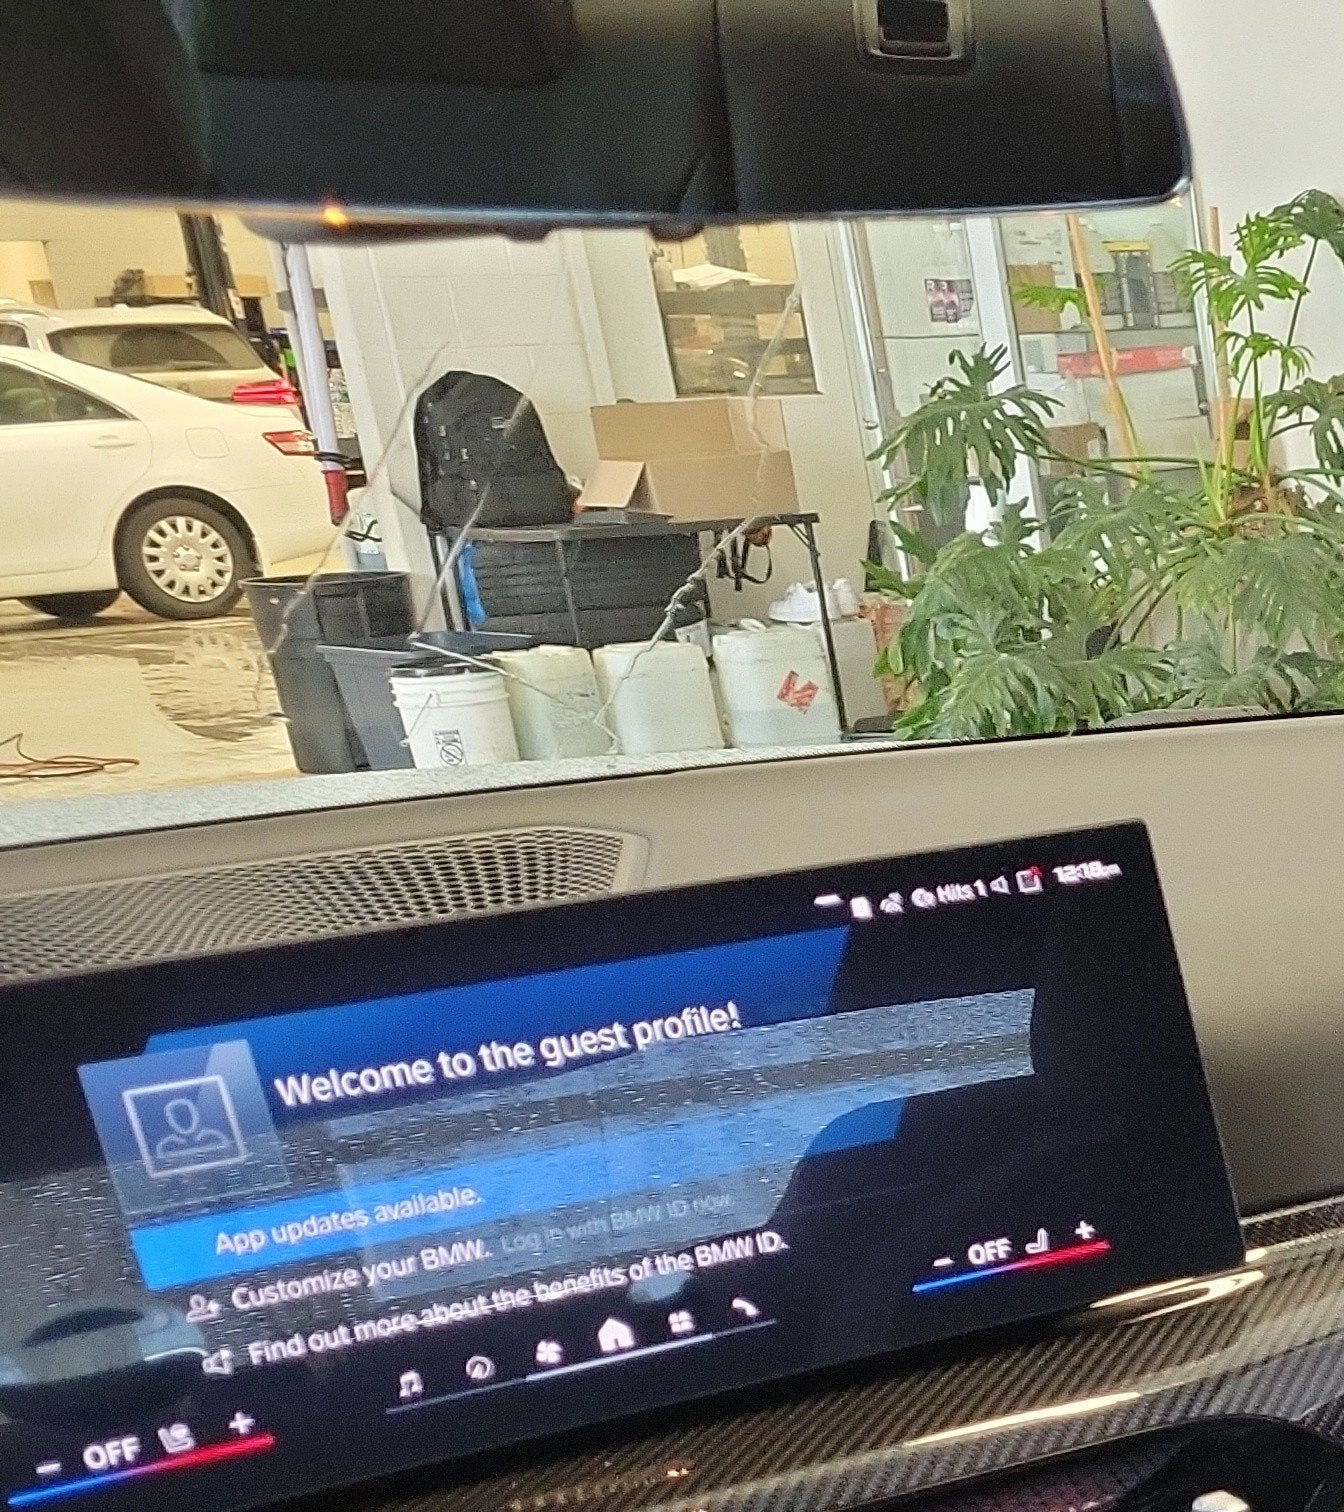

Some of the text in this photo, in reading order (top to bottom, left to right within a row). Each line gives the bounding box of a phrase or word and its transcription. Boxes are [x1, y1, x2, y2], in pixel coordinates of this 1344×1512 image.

[273, 1001, 742, 1107] Welcome to the guest profile!
[215, 1186, 485, 1257] App updates available.
[610, 1207, 661, 1231] BMW
[666, 1198, 689, 1218] ID
[231, 1237, 494, 1312] Customize your BMW.
[967, 1236, 1014, 1266] OFF
[247, 1230, 790, 1367] Find out more about the benefits of the BMW ID.
[83, 1434, 142, 1471] OFF
